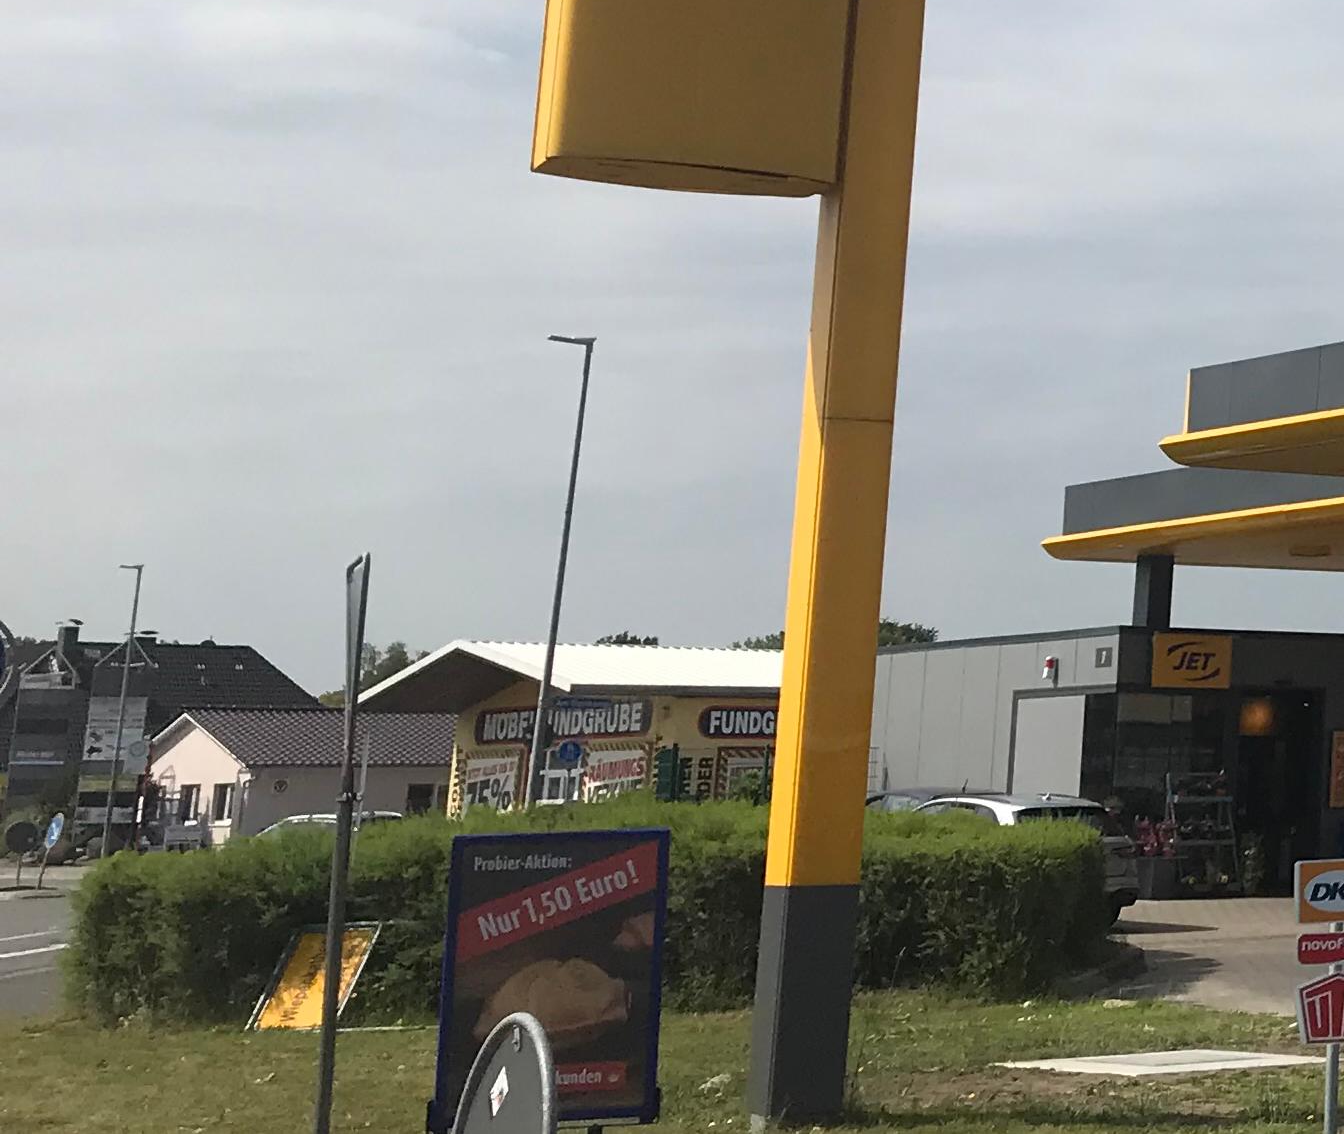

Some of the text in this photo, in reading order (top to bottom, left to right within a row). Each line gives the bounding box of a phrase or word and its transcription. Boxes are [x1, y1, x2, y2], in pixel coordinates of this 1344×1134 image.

[1173, 651, 1216, 671] JET
[474, 855, 573, 871] Probier-Aktion:
[477, 908, 521, 941] Nur
[522, 886, 573, 926] 1,50
